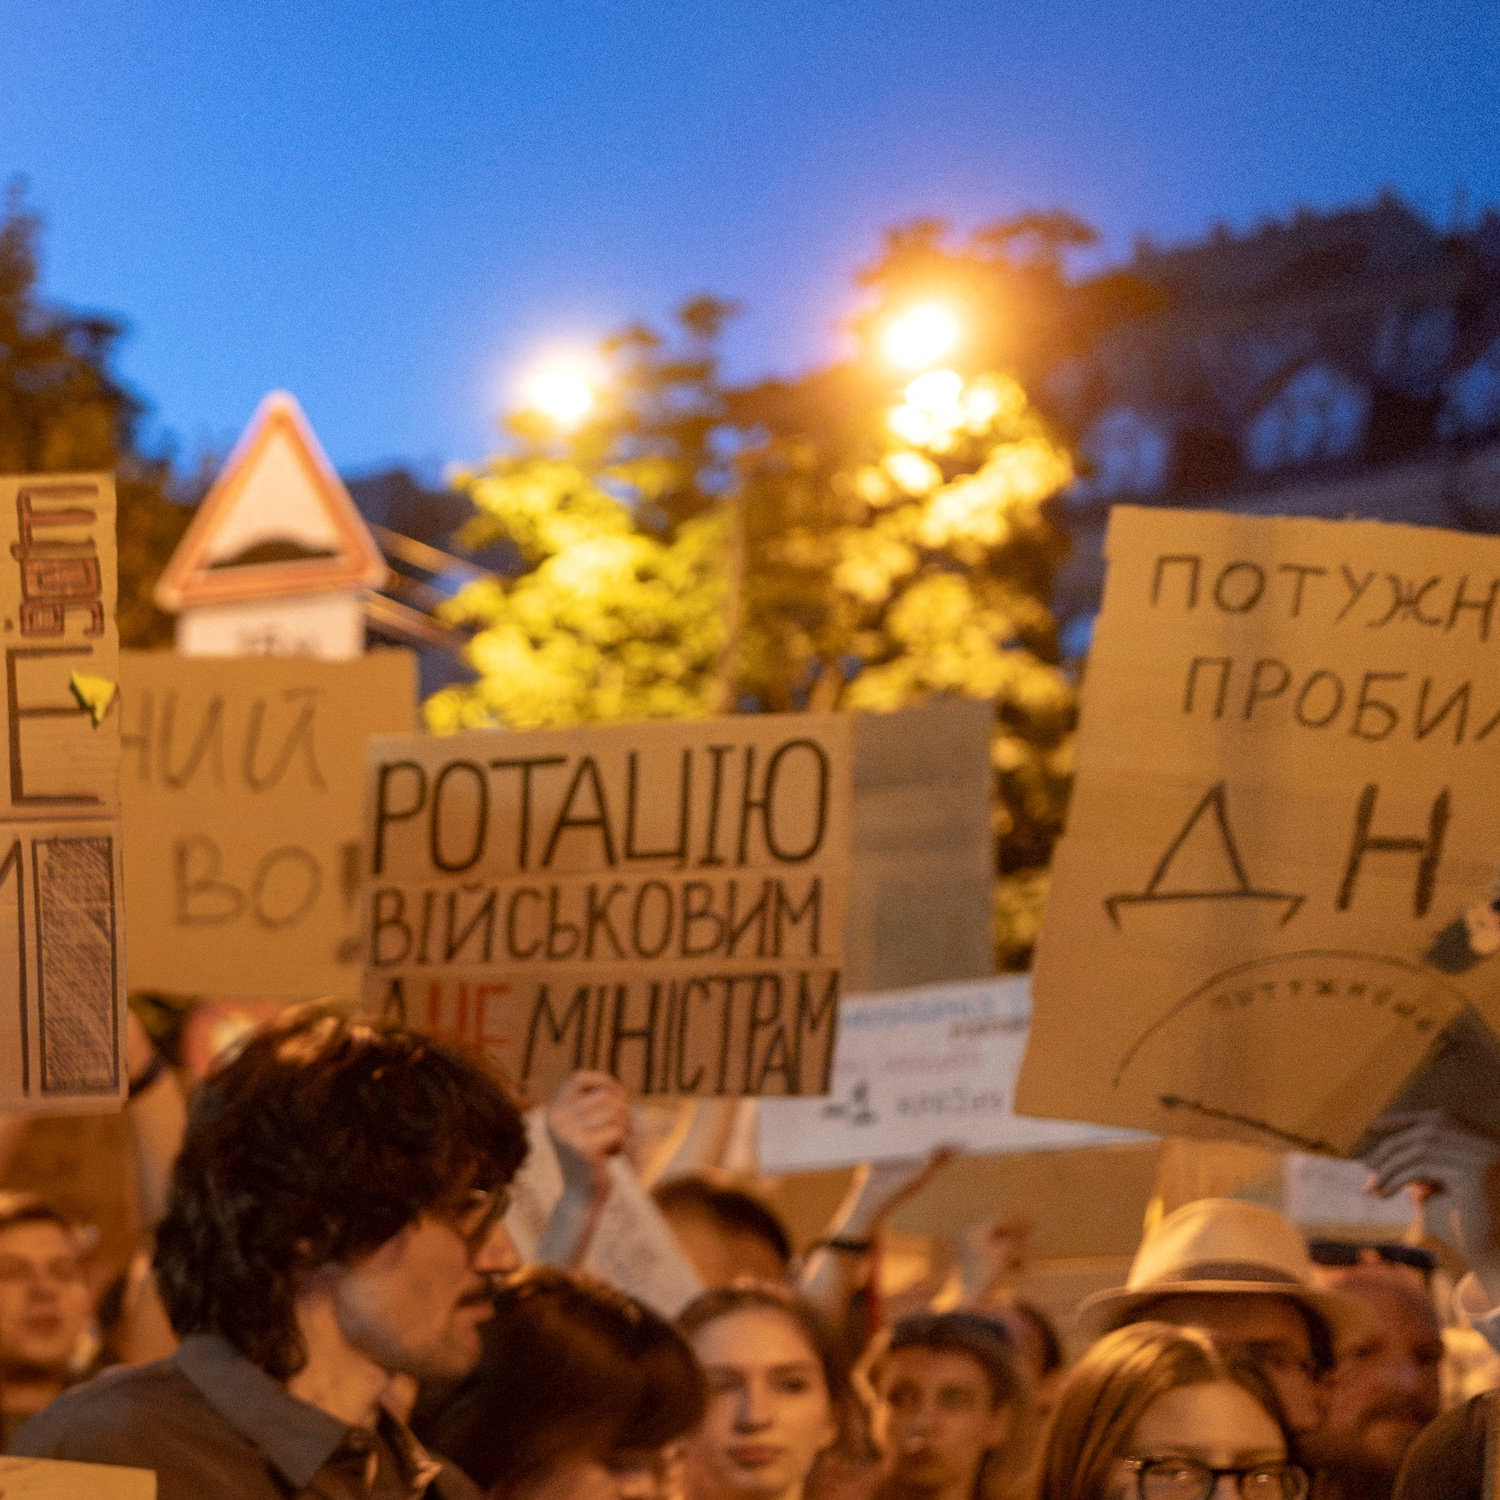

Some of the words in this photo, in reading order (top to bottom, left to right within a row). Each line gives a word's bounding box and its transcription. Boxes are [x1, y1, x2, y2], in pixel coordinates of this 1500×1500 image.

[372, 738, 832, 874] РОТАЦІЮ
[371, 874, 826, 968] ВІЙСЬКОВИМ
[519, 970, 840, 1097] МІНІСТРАМ
